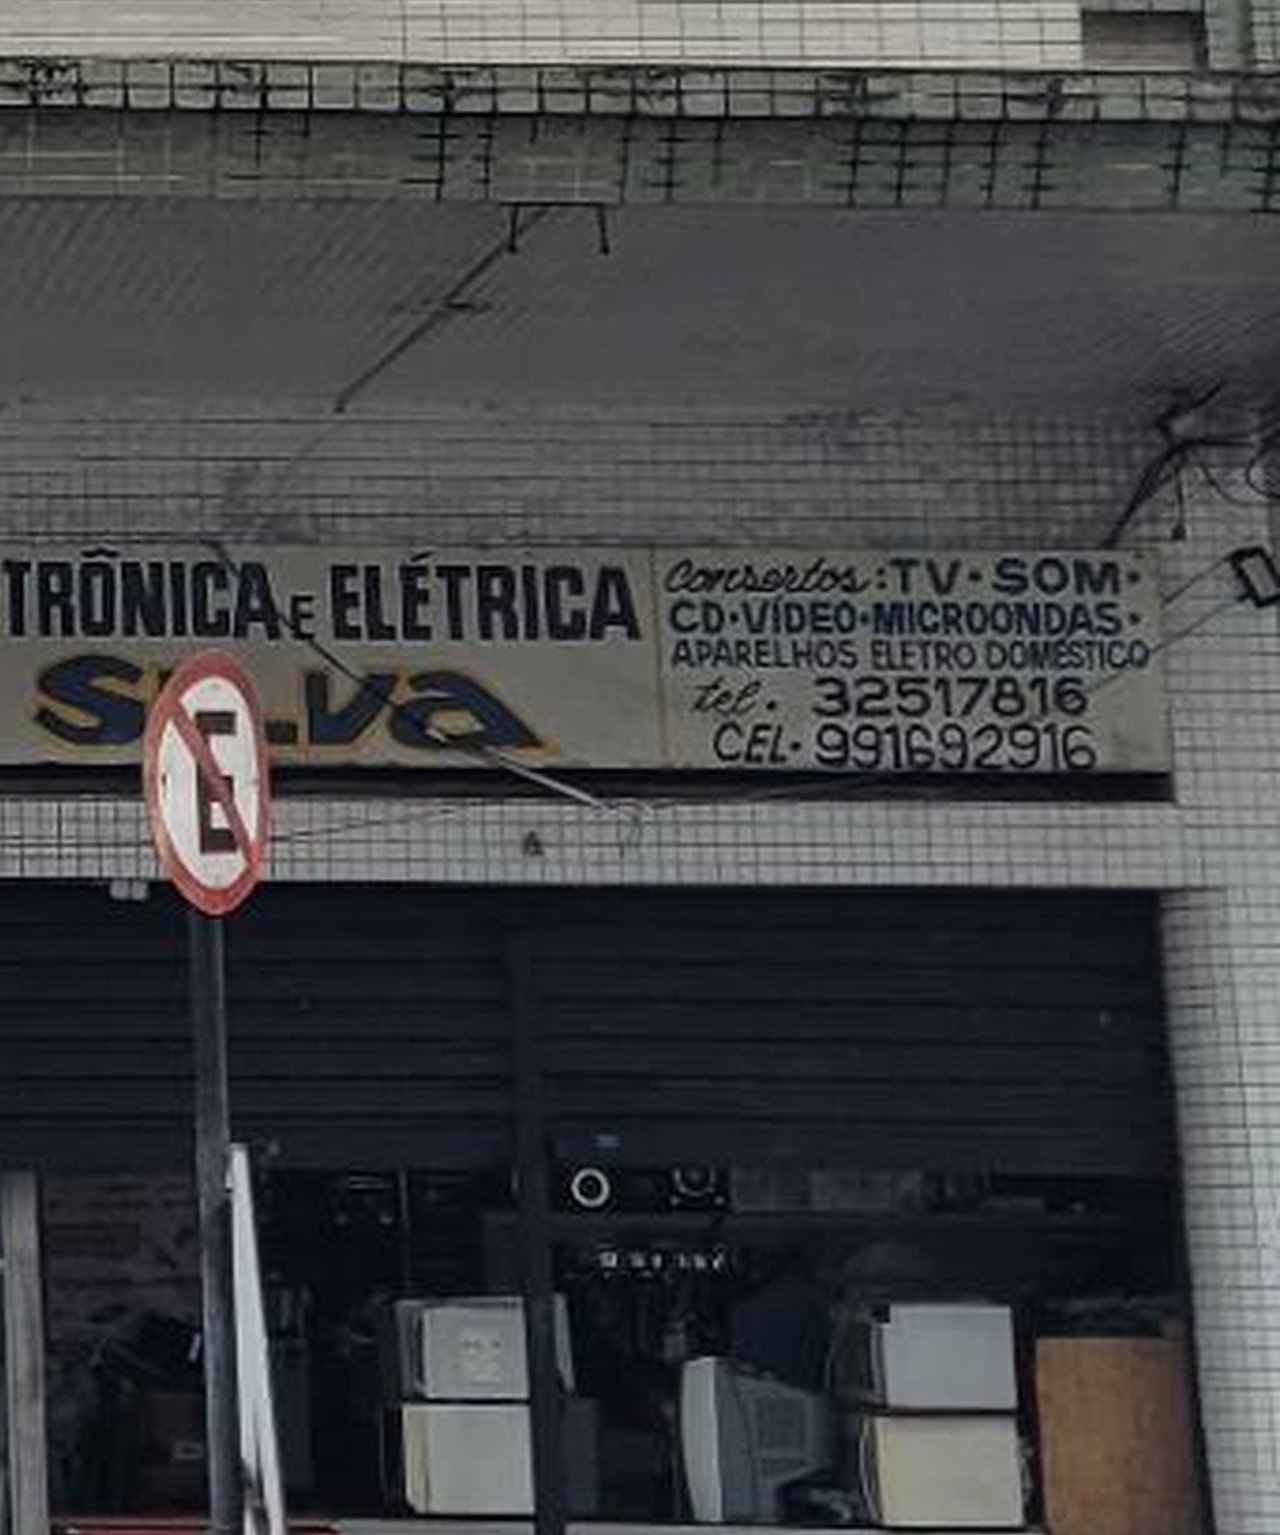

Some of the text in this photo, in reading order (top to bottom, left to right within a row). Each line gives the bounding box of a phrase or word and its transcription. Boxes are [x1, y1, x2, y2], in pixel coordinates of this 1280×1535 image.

[331, 550, 642, 641] ELÉTRICA
[672, 639, 859, 670] APARELHOS
[872, 640, 977, 671] ELETRO
[813, 677, 1087, 717] 32517816
[815, 723, 1097, 770] 991692916
